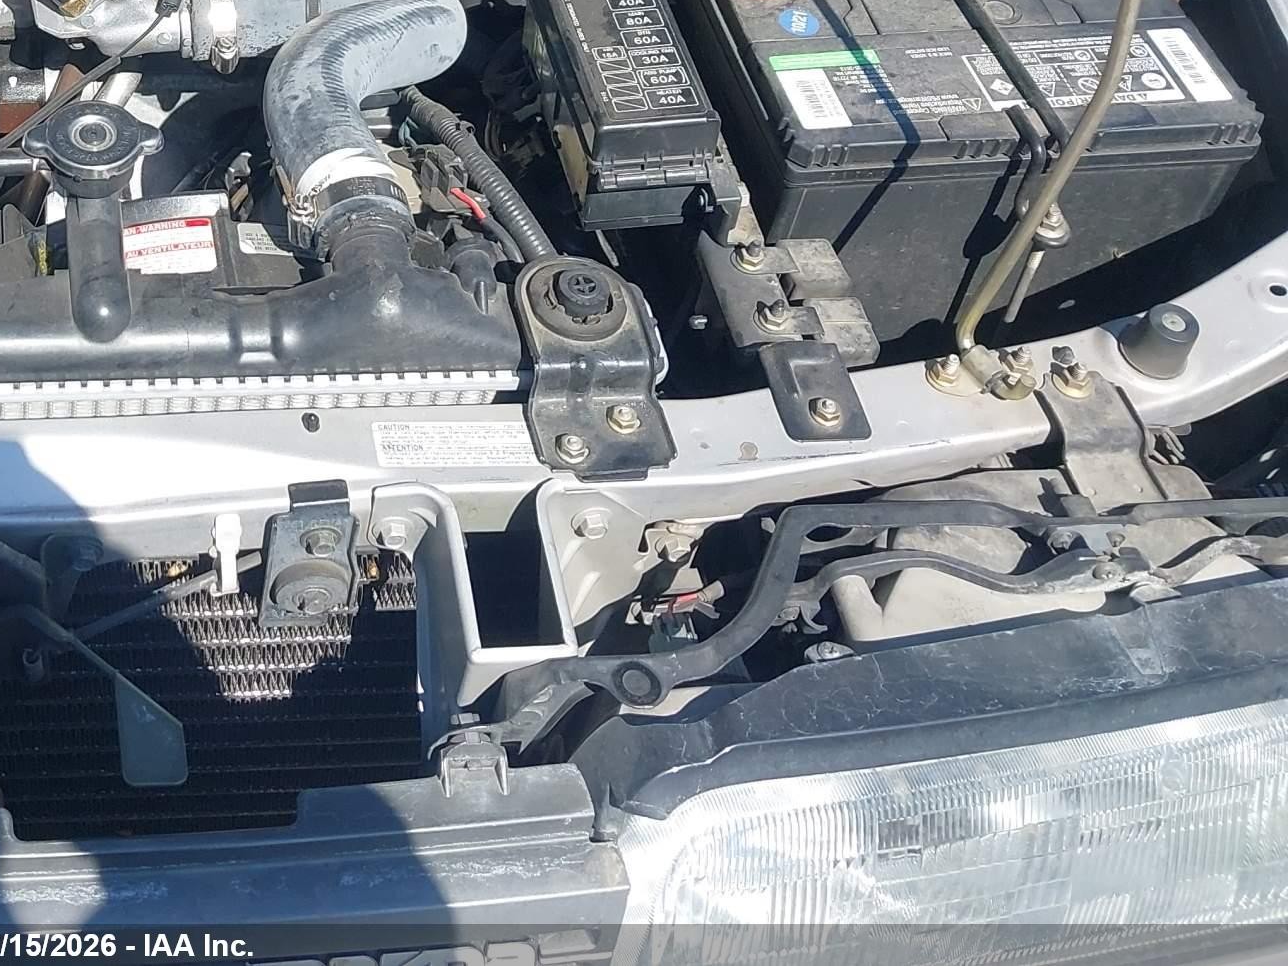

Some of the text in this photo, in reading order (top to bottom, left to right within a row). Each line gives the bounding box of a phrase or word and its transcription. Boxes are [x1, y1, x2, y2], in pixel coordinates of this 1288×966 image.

[626, 16, 652, 26] 80A
[633, 35, 661, 44] 60A
[642, 55, 669, 64] 30A
[650, 75, 678, 84] 60A
[659, 94, 686, 104] 40A
[141, 241, 212, 255] VENTILATEUR
[382, 444, 424, 452] ATTENTION
